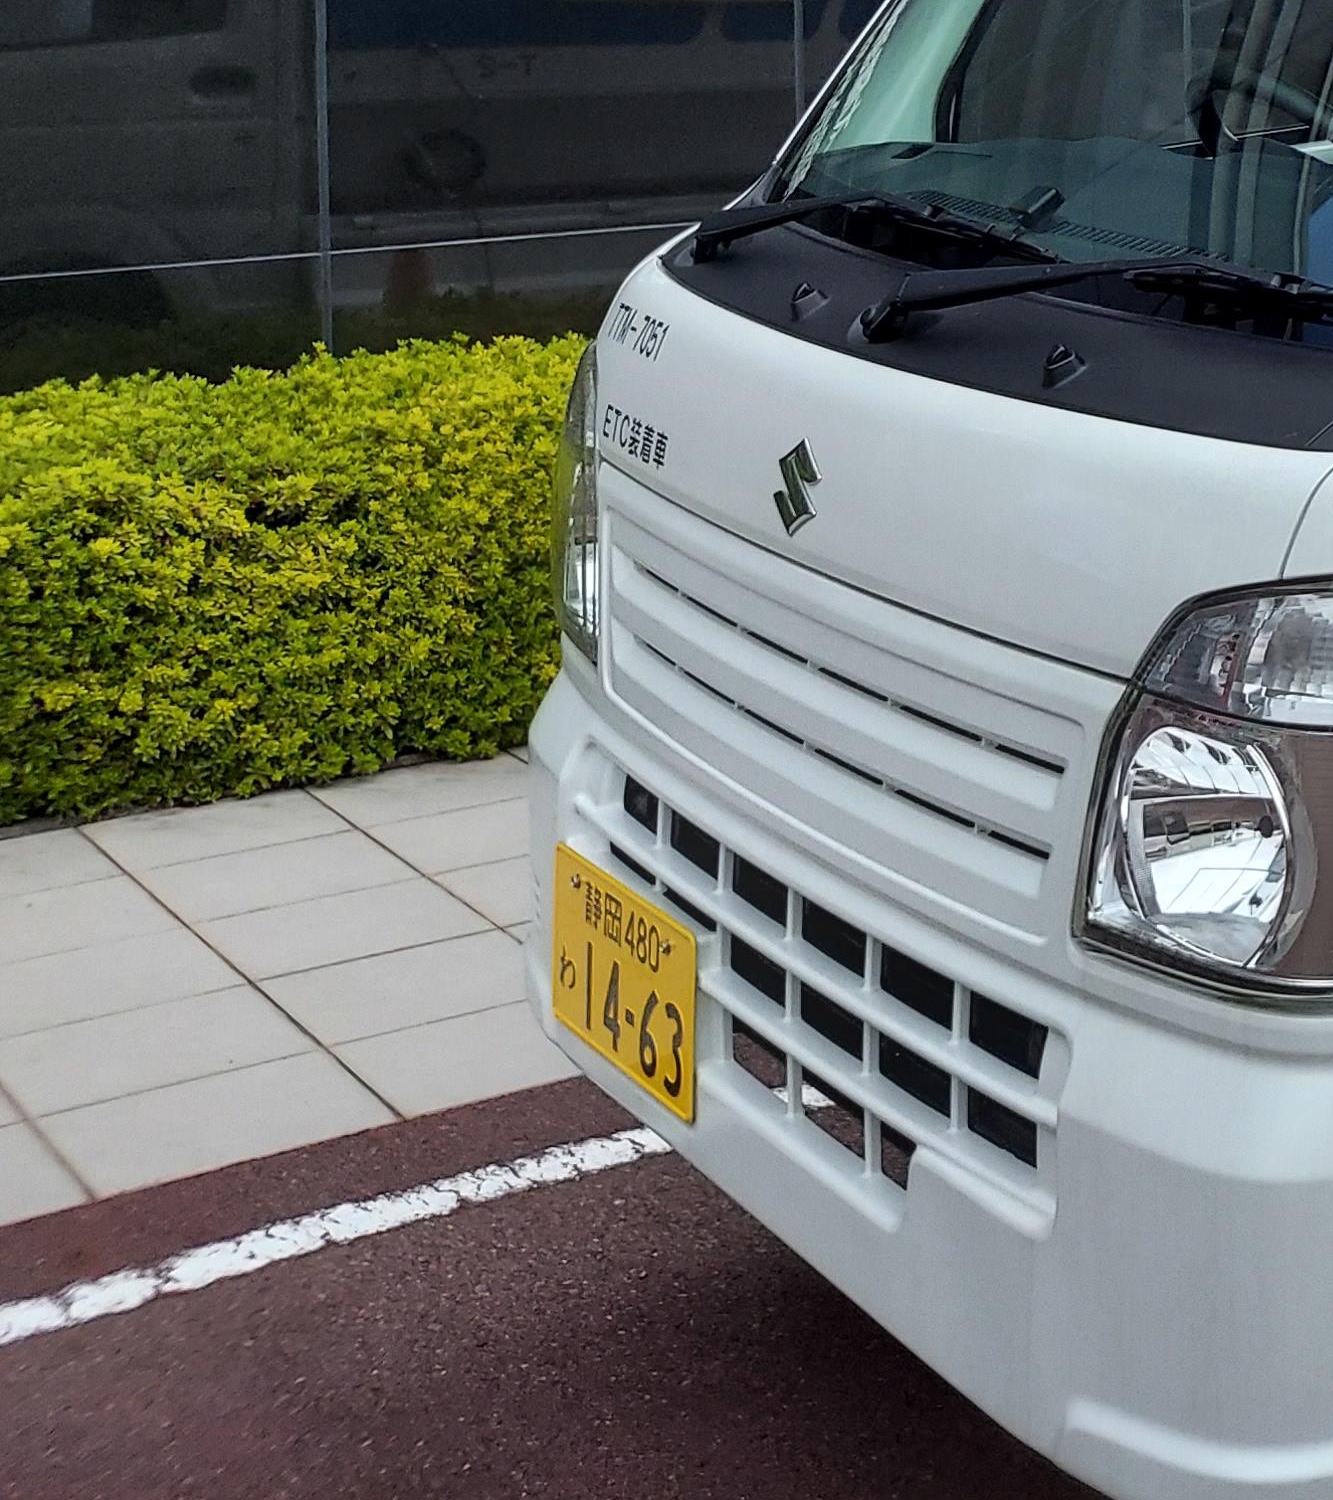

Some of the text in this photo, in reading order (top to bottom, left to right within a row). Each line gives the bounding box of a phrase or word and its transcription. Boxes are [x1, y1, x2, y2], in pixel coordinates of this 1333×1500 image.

[608, 303, 670, 361] TTM-7051
[603, 404, 669, 470] ETC装着車
[560, 941, 683, 1097] わ 14-63
